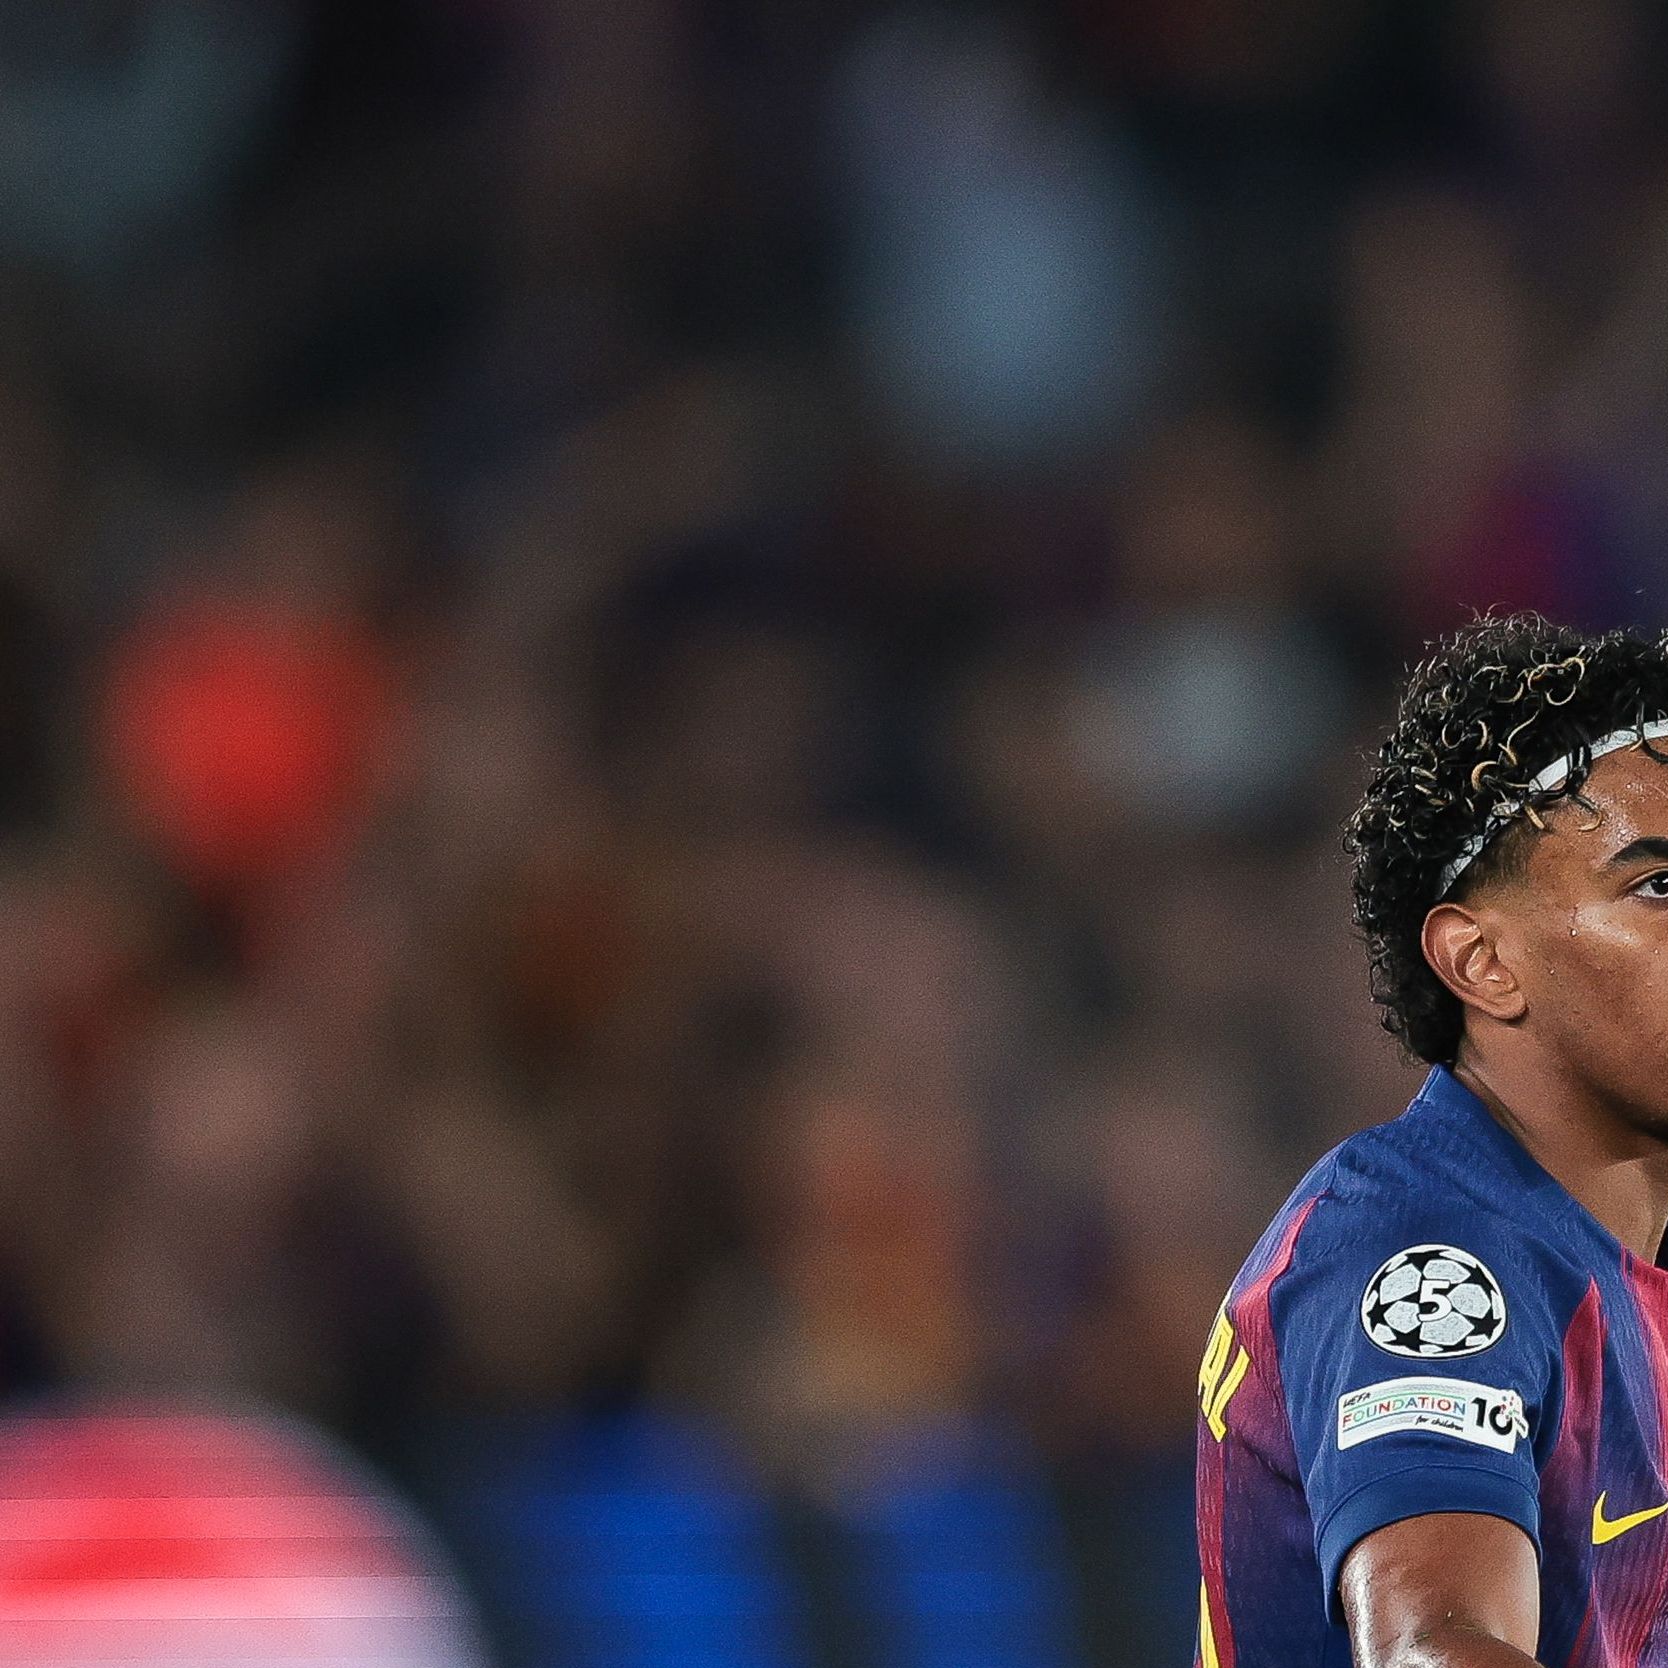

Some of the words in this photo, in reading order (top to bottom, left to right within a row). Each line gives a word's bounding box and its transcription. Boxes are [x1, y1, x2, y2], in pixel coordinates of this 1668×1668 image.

[1418, 1279, 1453, 1322] 5
[1342, 1396, 1467, 1428] FOUNDATION
[1343, 1391, 1371, 1408] UEFA
[1431, 1418, 1464, 1432] children
[1471, 1397, 1514, 1436] 10
